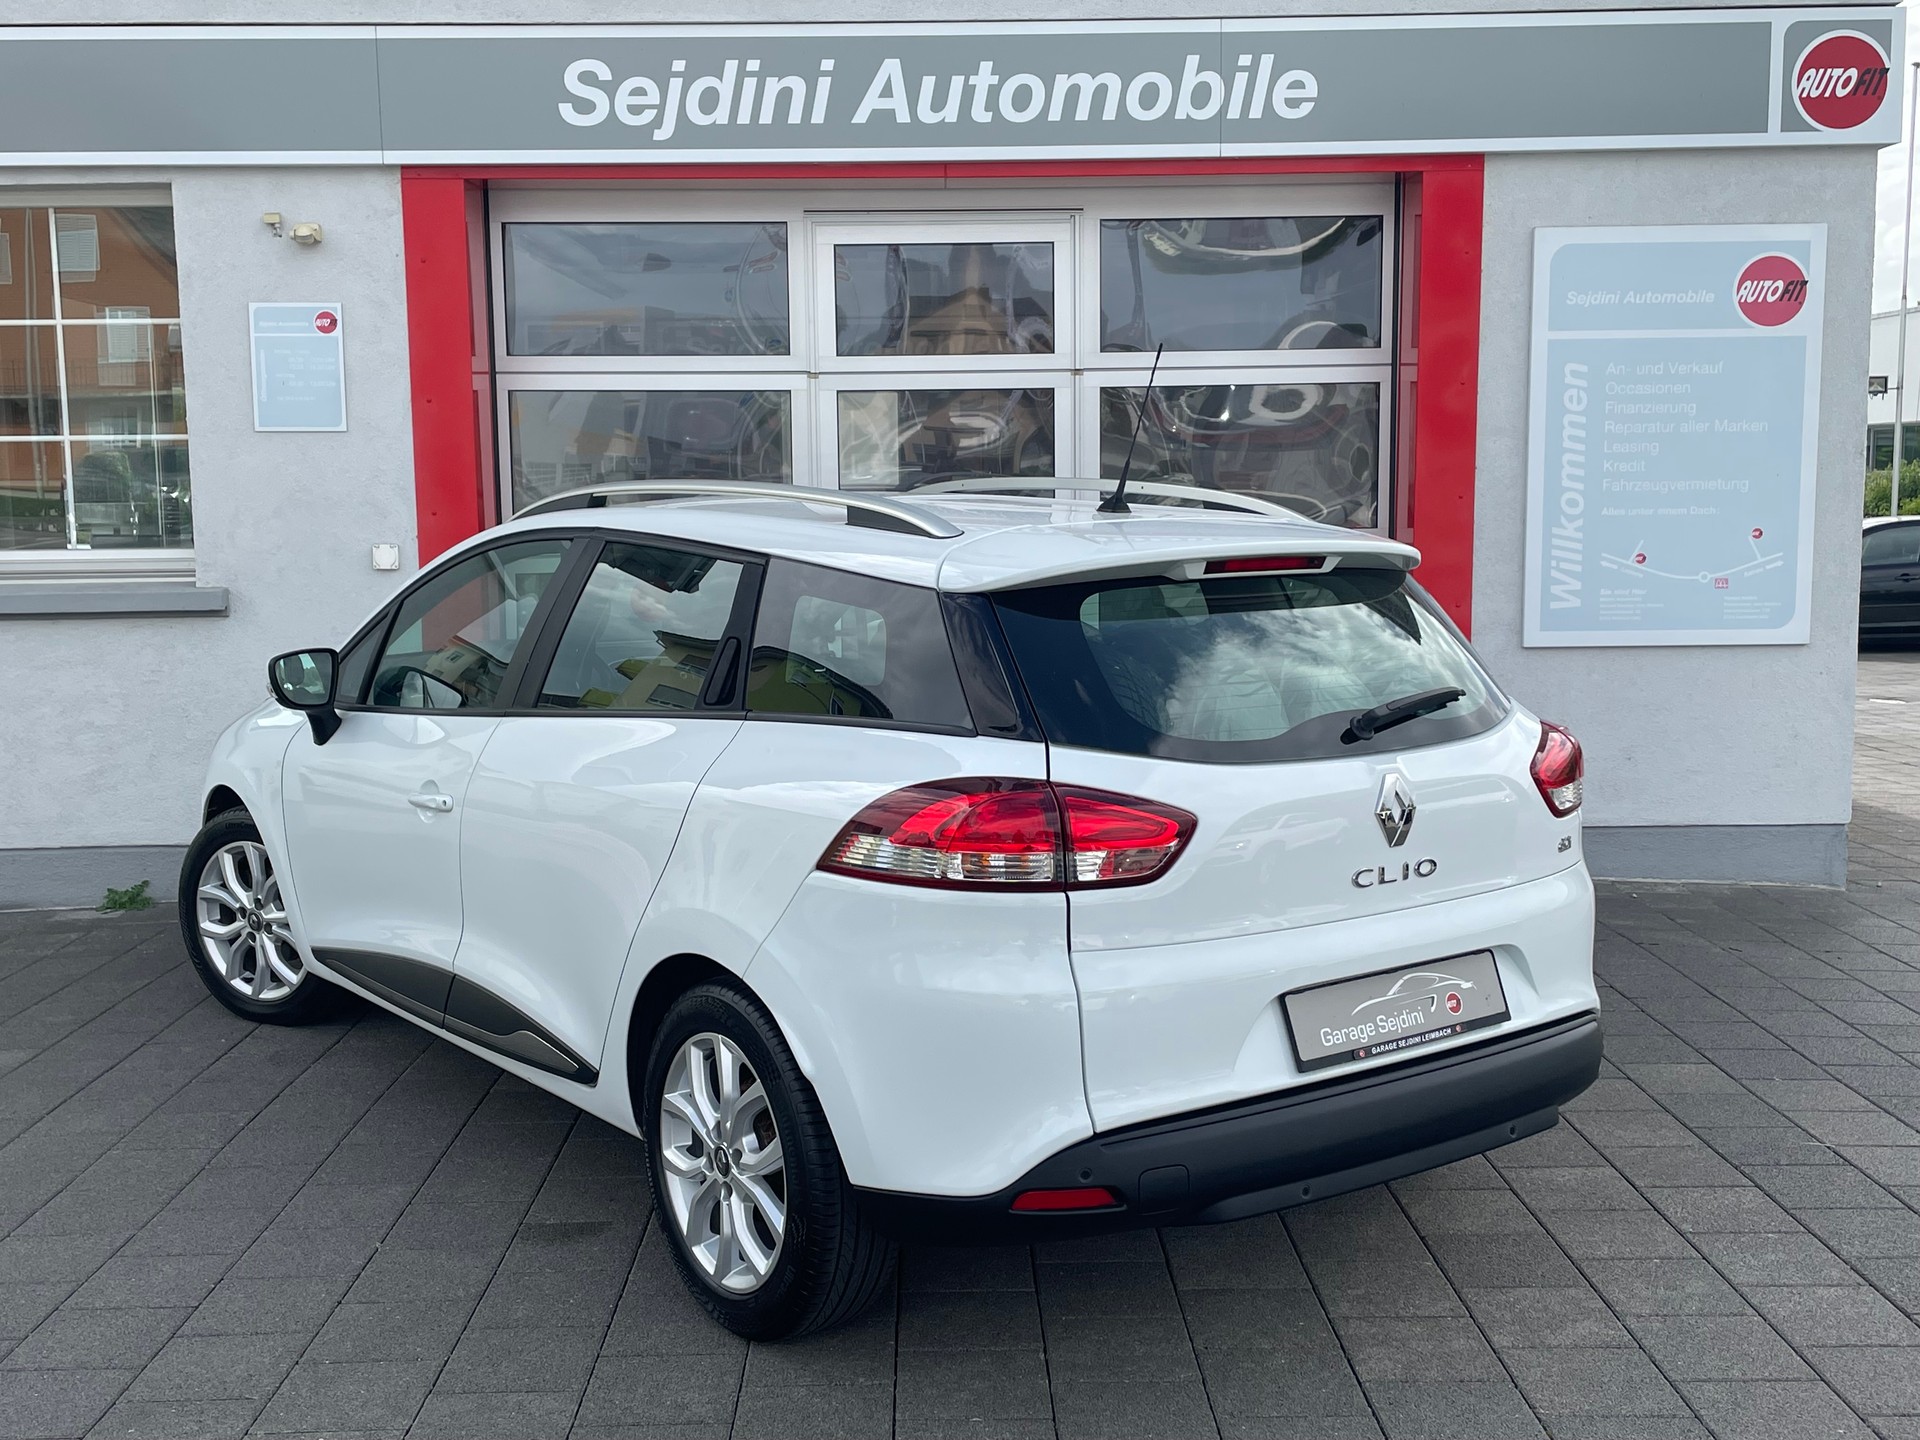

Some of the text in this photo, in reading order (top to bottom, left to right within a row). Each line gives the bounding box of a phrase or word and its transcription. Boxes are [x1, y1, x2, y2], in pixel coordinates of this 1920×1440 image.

[557, 52, 1319, 141] Sejdini Automobile
[1566, 289, 1715, 308] Sejdini Automobile
[1605, 360, 1725, 376] An- und Verkauf
[1605, 381, 1691, 395] Occasionen
[1605, 401, 1697, 416] Finanzierung
[1604, 418, 1769, 437] Reparatur aller Marken
[1603, 440, 1660, 456] Leasing
[1603, 459, 1646, 473] Kredit
[1550, 361, 1588, 610] Willkommen
[1602, 477, 1750, 494] Fahrzeugvermietung
[1601, 506, 1626, 516] Alles
[1628, 506, 1655, 516] unter
[1657, 506, 1688, 516] einem
[1351, 856, 1438, 888] CLIO
[1319, 1006, 1425, 1048] Garage Sejdini
[1371, 1027, 1452, 1055] GARAGE SEJDINI LEIMBACH
